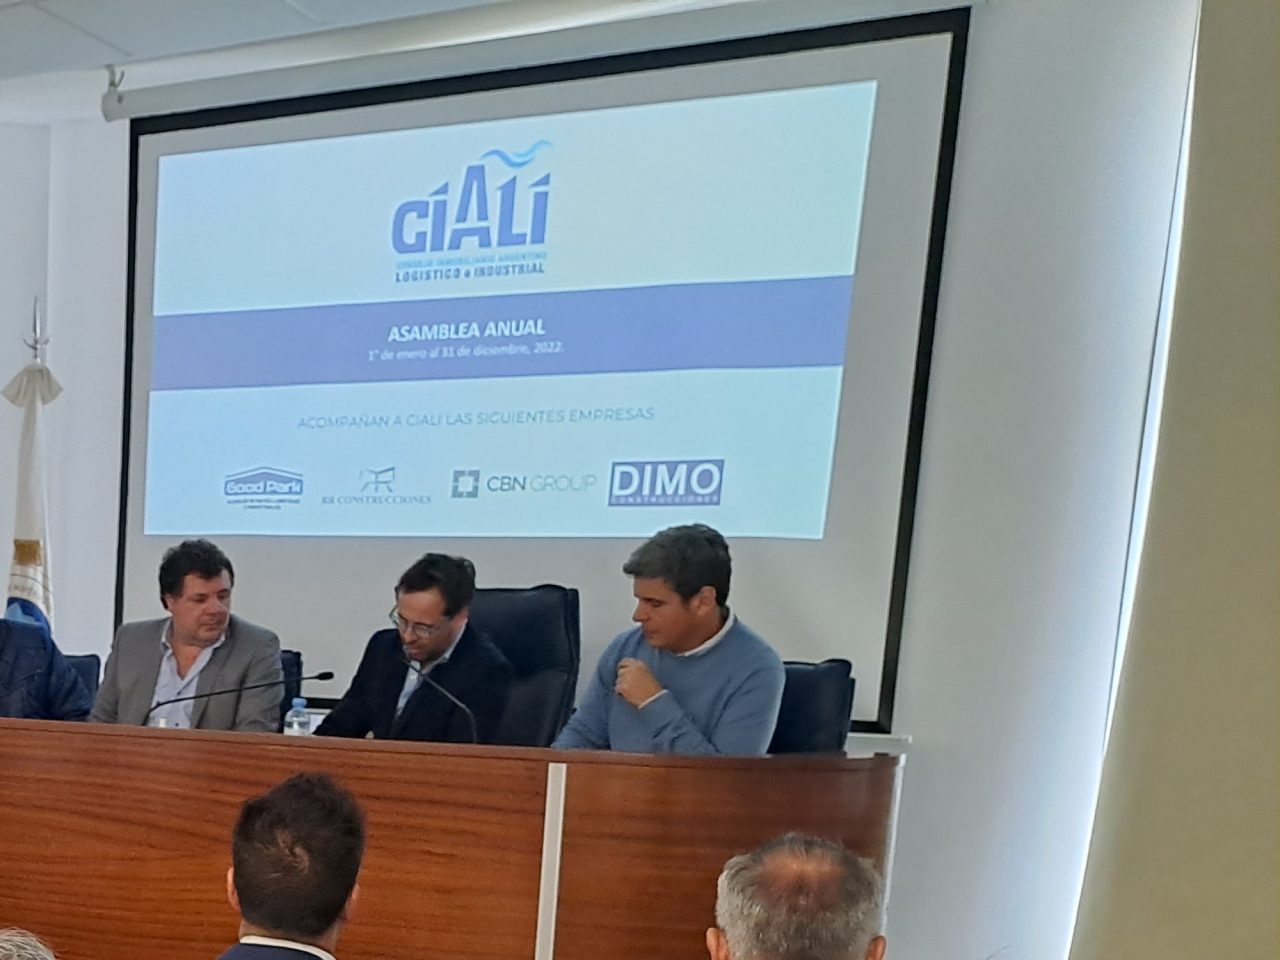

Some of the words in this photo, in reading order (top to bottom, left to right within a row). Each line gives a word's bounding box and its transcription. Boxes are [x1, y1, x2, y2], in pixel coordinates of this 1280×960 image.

[474, 262, 545, 277] INDUSTRIAL
[388, 321, 480, 342] ASAMBLEA
[483, 318, 546, 337] ANUAL
[381, 348, 394, 360] de
[457, 345, 470, 357] de
[393, 414, 402, 426] A
[446, 412, 472, 426] LAS
[476, 409, 565, 425] SIGUIENTES
[568, 406, 655, 423] EMPRESAS
[227, 480, 263, 494] Good
[266, 480, 300, 494] Park
[487, 476, 527, 492] CBN
[530, 474, 597, 491] GROUP
[611, 463, 721, 497] DIMO
